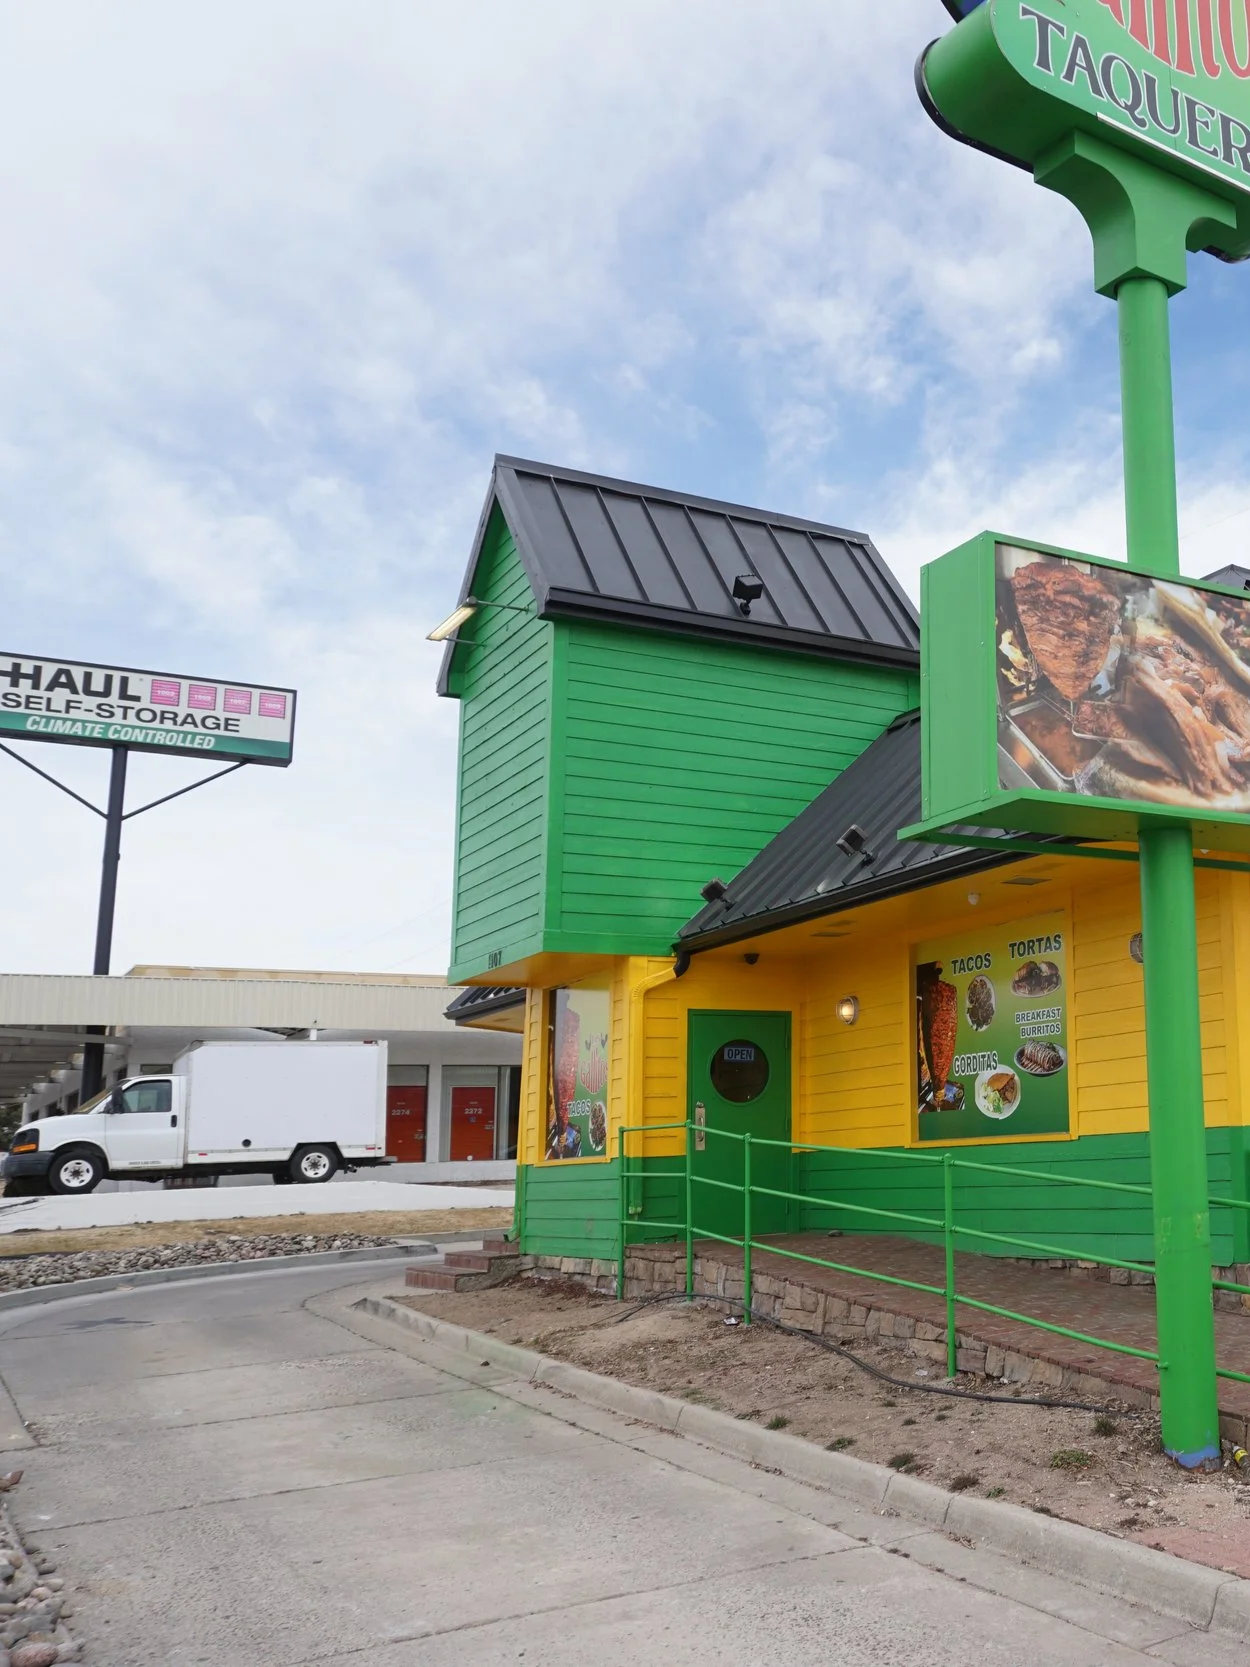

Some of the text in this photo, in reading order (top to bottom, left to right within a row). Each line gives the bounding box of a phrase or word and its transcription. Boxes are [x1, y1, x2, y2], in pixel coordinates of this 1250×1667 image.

[1, 692, 241, 733] SELF-STORAGE
[26, 716, 215, 749] CLIMATE CONTROLLED
[1008, 933, 1062, 960] TORTAS
[951, 952, 992, 975] TACOS
[1015, 1007, 1062, 1024] BREAKFAST
[1020, 1023, 1061, 1038] BURRITOS
[727, 1048, 752, 1060] OPEN
[953, 1051, 998, 1076] GORDITAS
[567, 1099, 591, 1117] TACOS
